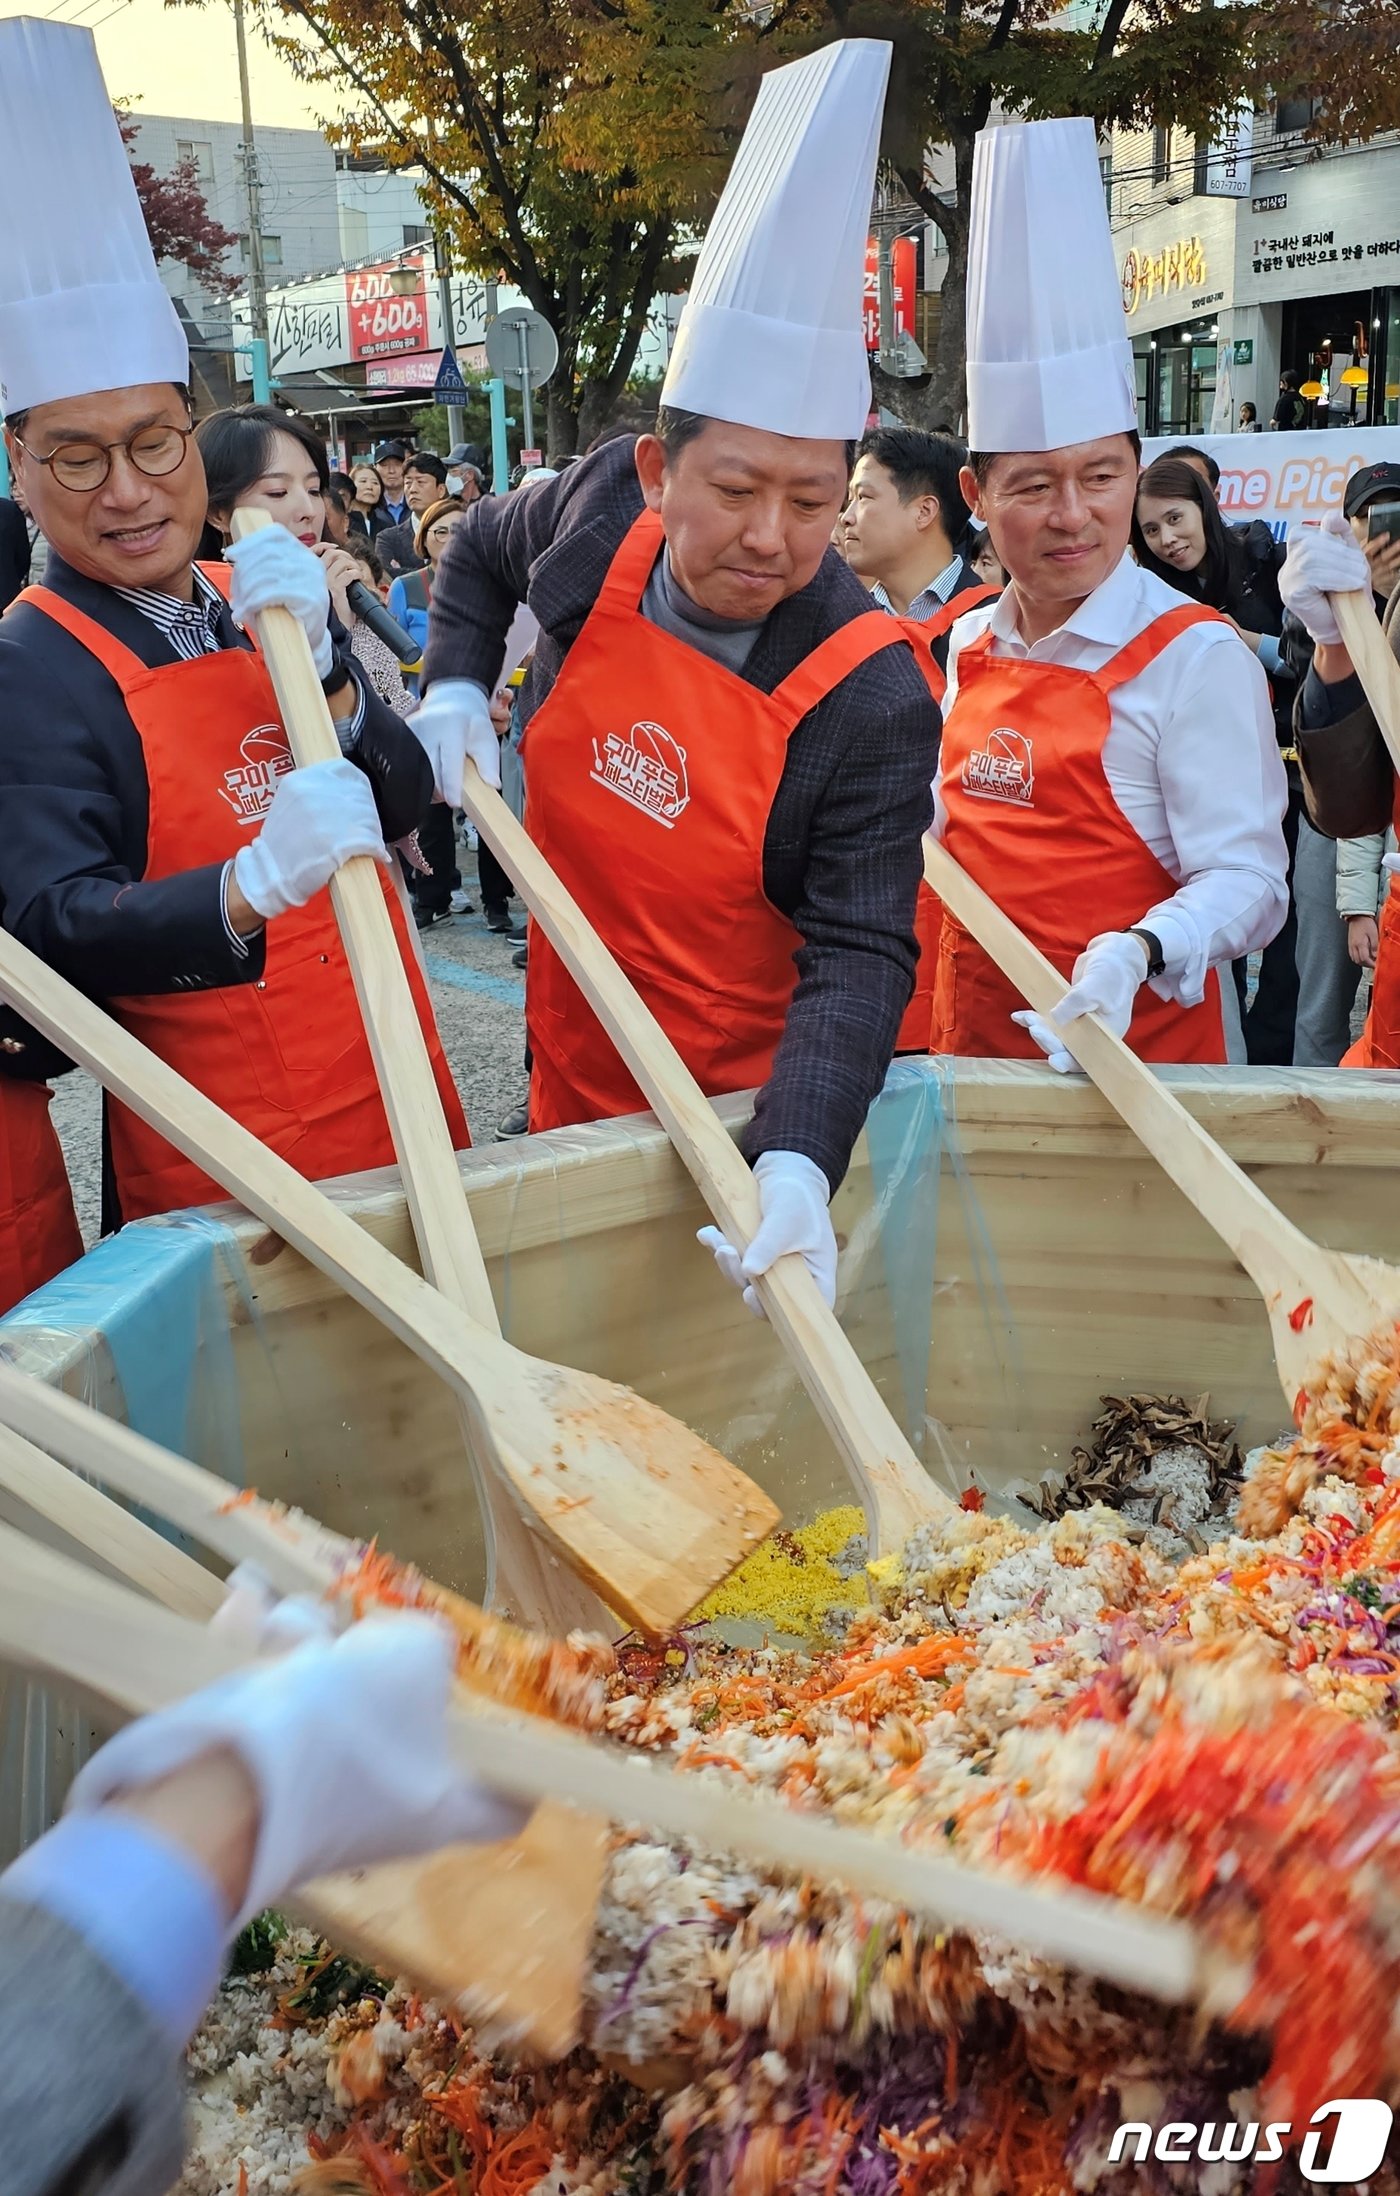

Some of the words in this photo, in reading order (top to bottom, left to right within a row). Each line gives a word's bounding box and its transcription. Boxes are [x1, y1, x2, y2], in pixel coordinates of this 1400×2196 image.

[1210, 180, 1247, 192] 607-7707
[1302, 231, 1334, 247] 돼지에
[1252, 256, 1283, 273] 깔끔한
[1341, 244, 1363, 261] 맛을
[604, 761, 665, 813] 페스티벌
[969, 773, 1020, 799] 페스티벌
[241, 788, 277, 813] 페스
